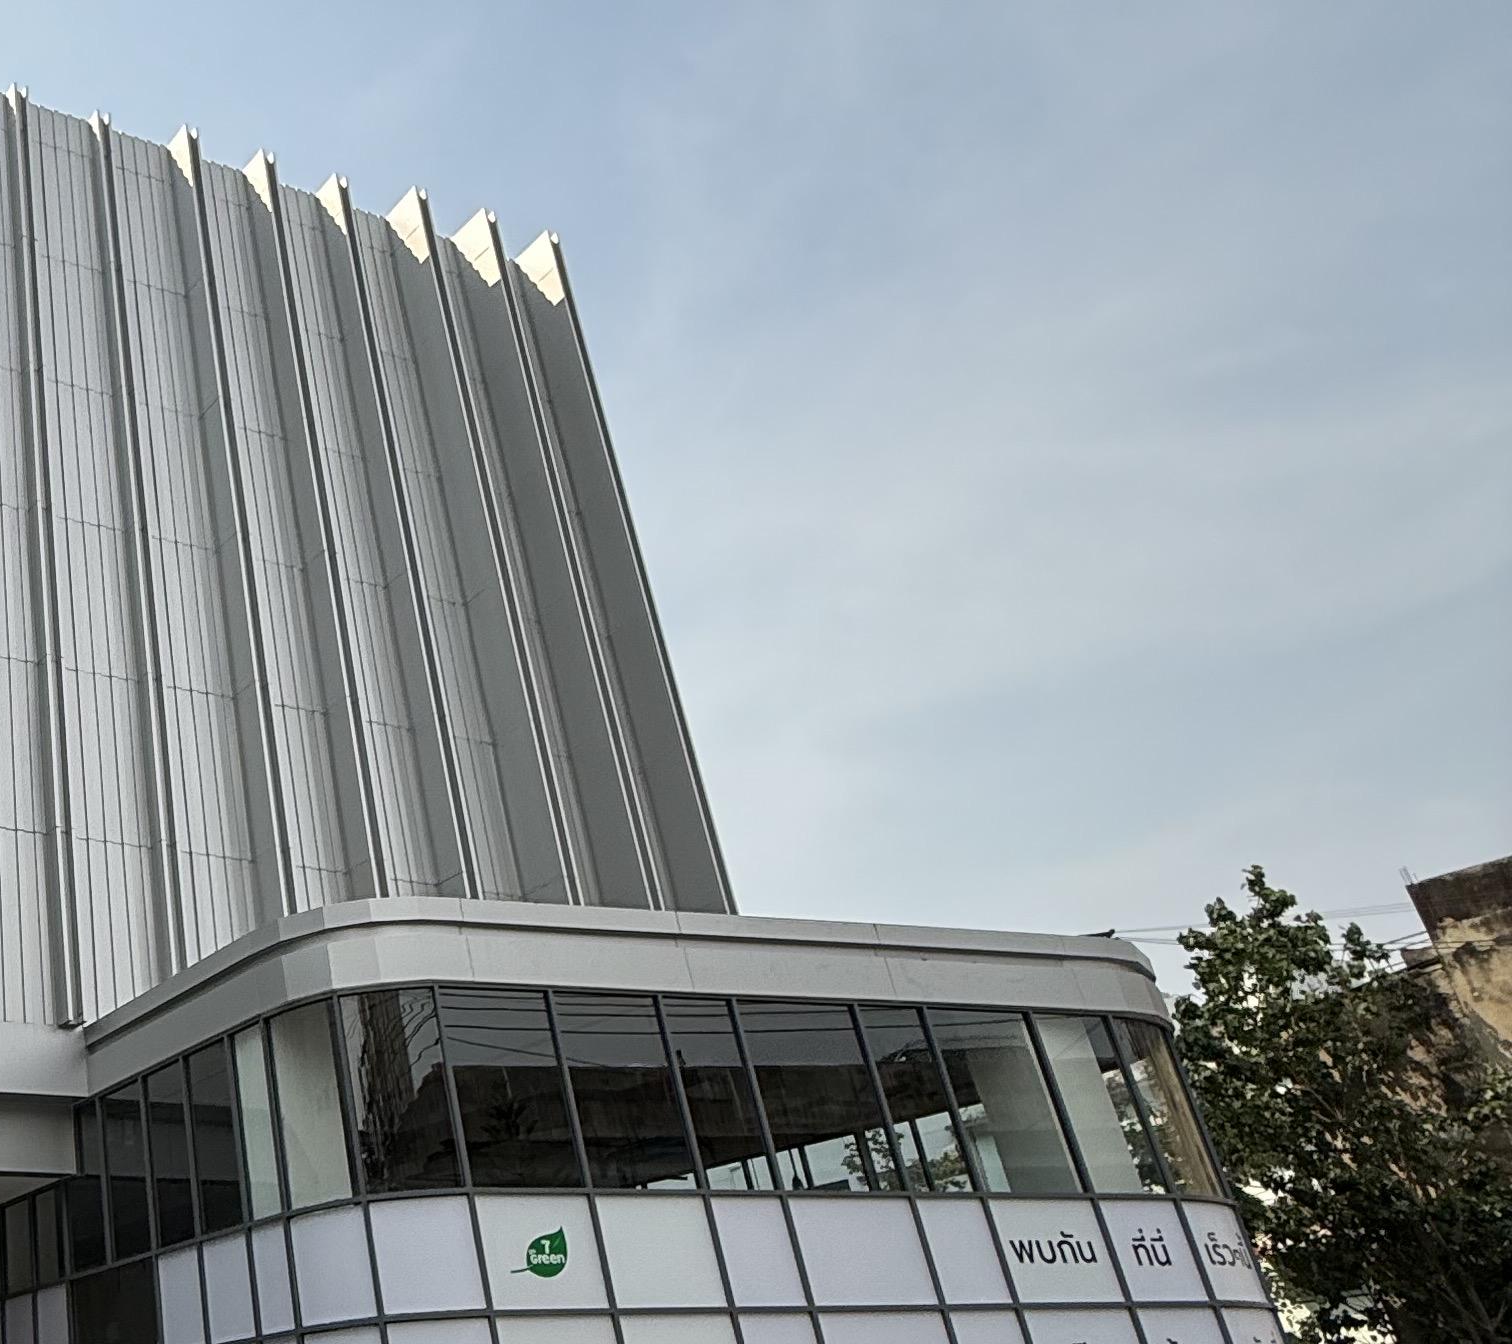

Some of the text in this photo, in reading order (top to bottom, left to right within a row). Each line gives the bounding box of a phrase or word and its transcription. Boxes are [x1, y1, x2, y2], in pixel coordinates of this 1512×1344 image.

[529, 1254, 565, 1265] Green
[1009, 1231, 1098, 1265] พบกัน
[1131, 1228, 1173, 1267] ที่นี่
